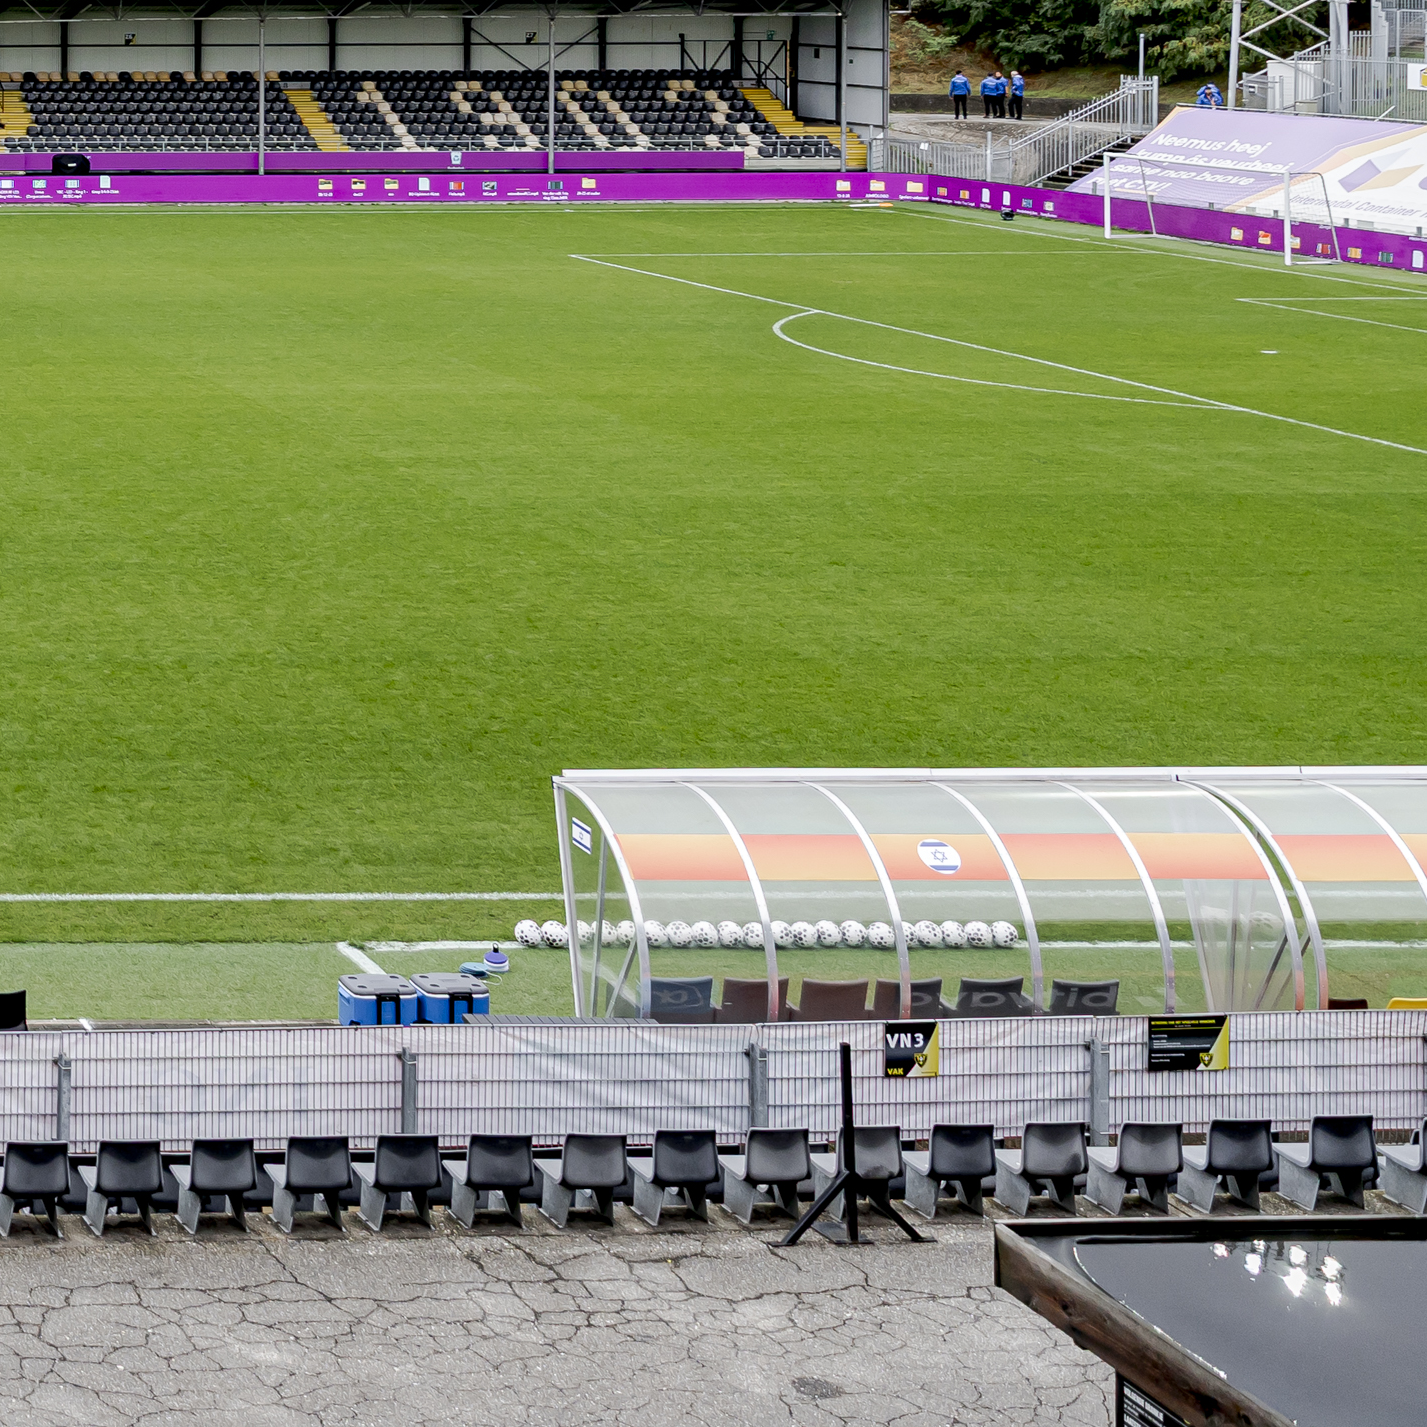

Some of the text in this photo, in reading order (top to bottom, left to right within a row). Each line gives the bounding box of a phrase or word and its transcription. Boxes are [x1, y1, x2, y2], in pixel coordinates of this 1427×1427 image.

[1150, 133, 1272, 158] Neemus heej
[1355, 201, 1422, 217] Container
[887, 1067, 904, 1075] VAK
